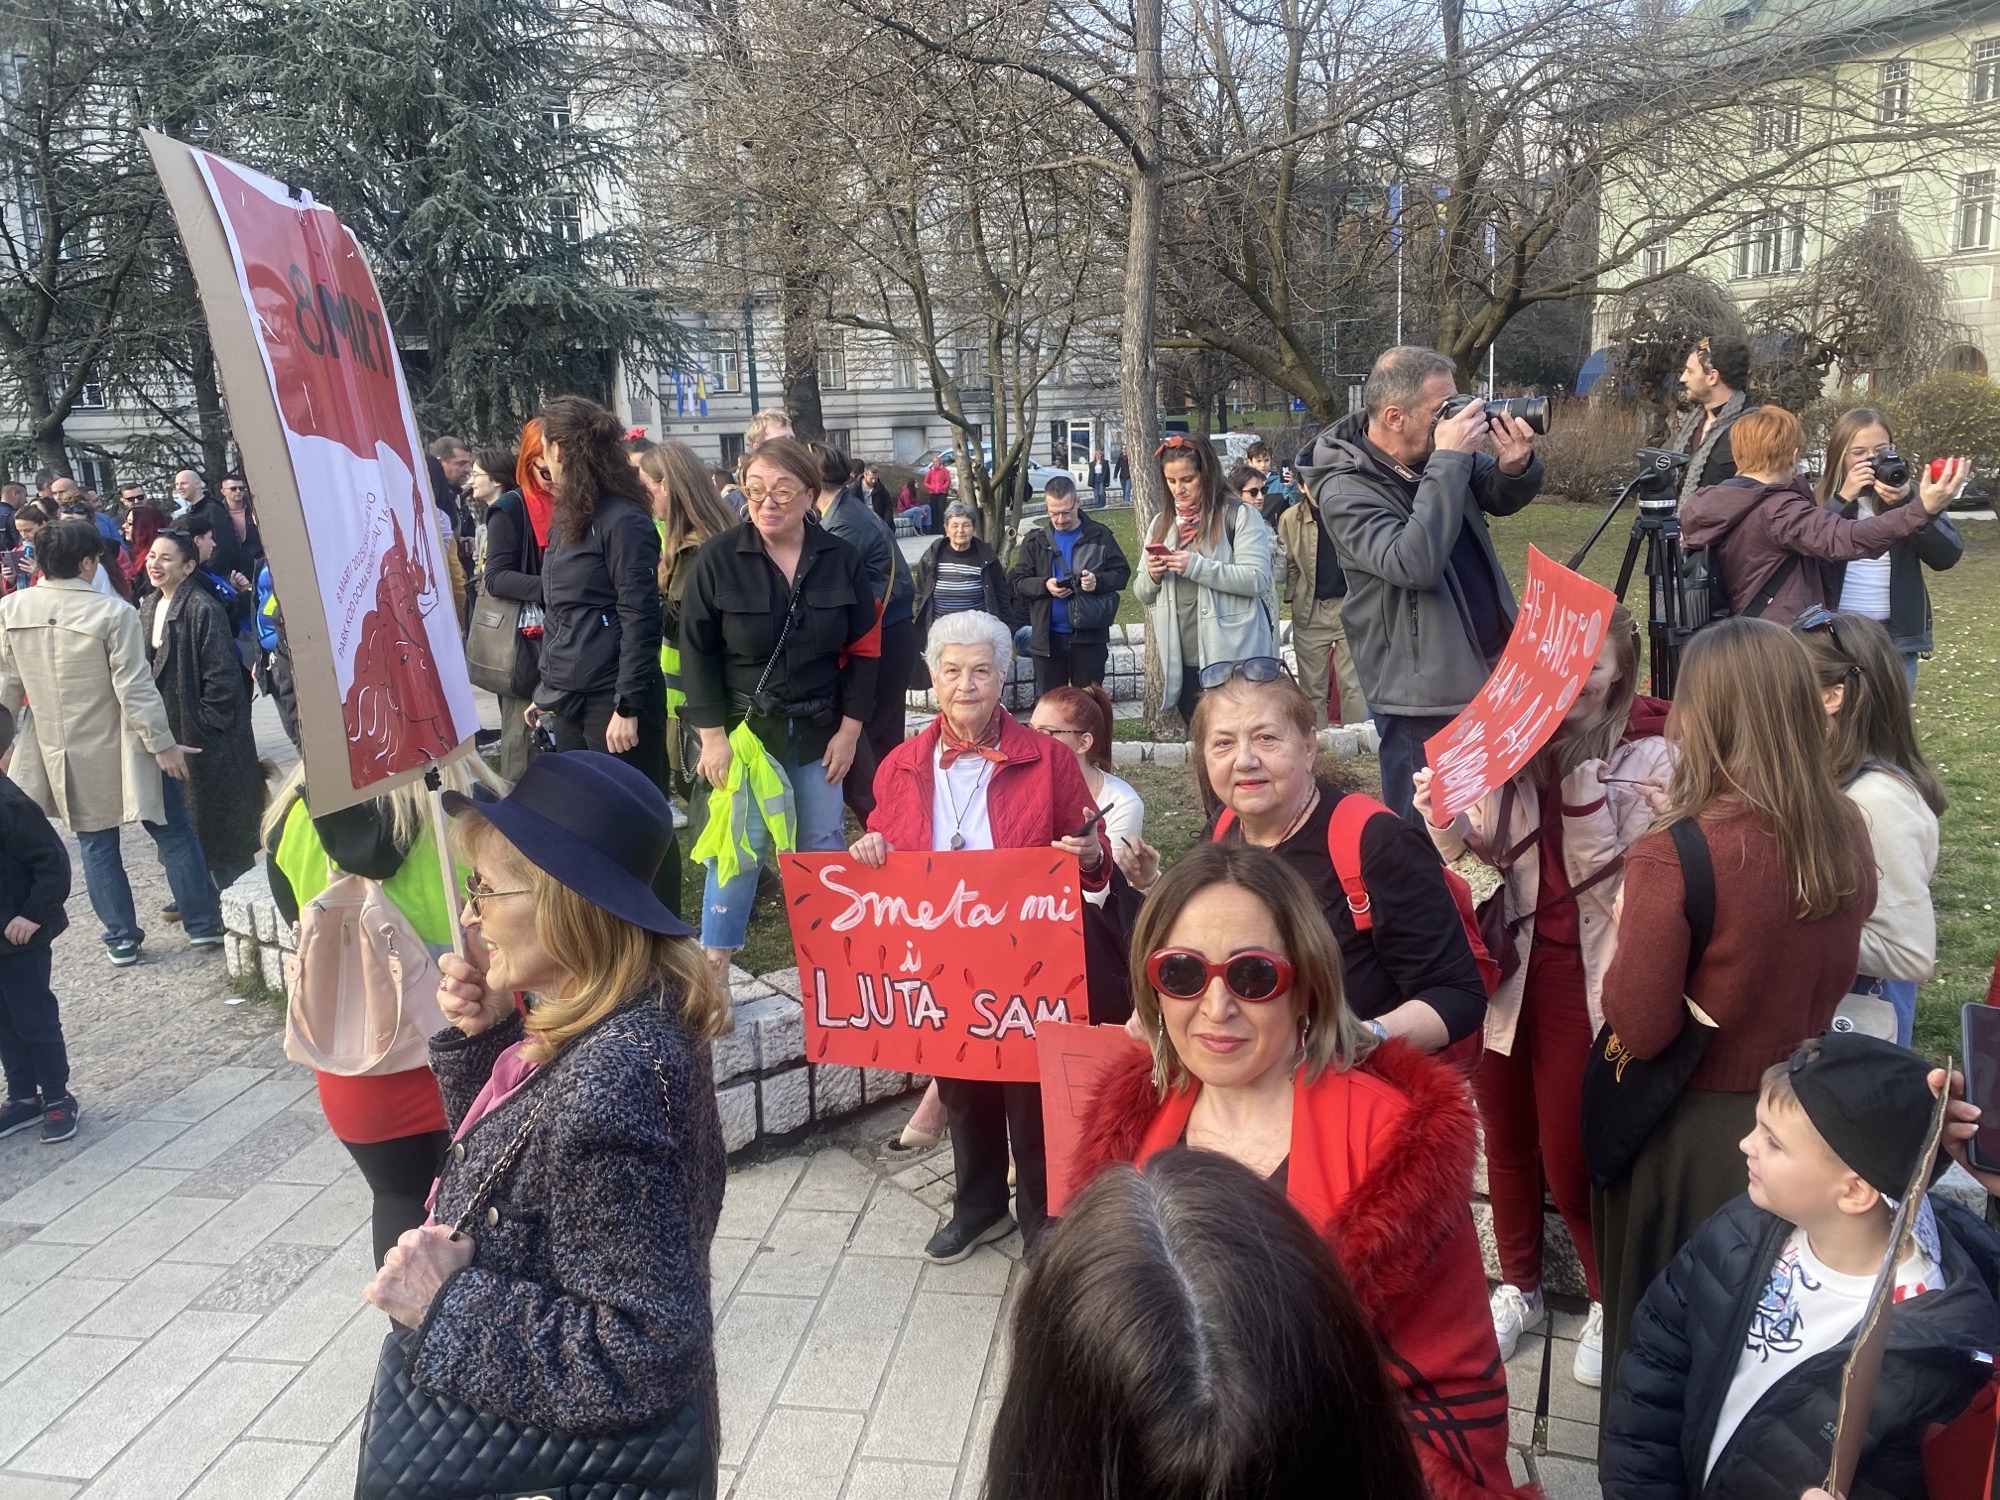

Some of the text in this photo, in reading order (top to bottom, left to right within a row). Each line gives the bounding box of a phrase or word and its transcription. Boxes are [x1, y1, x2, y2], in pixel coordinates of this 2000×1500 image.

[337, 625, 350, 659] PARK
[345, 601, 356, 628] KOD
[352, 575, 370, 605] DOMA
[818, 864, 1079, 932] Smeta mi
[899, 940, 922, 973] i
[813, 967, 1071, 1042] LJUTA SAM
